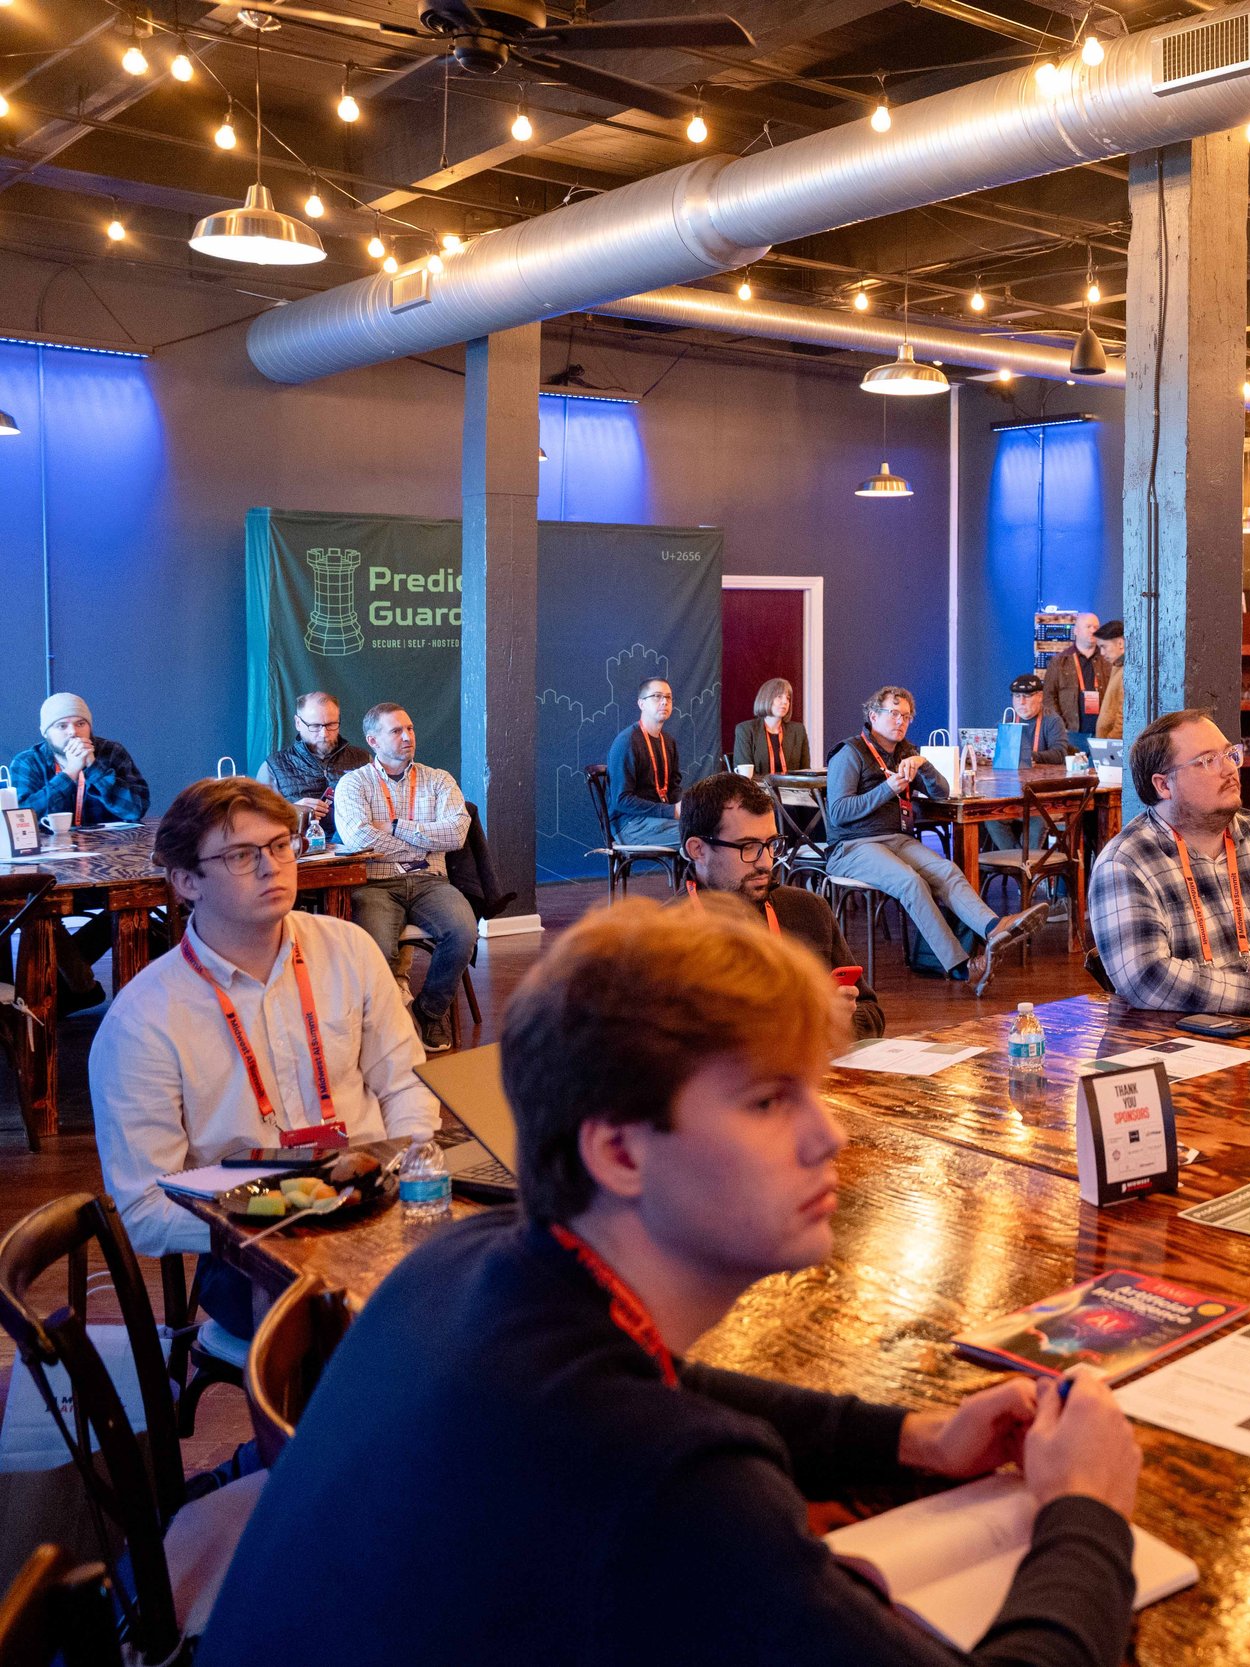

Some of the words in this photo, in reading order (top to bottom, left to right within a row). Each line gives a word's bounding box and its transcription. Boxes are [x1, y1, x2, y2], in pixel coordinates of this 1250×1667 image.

[661, 550, 701, 561] U+2656
[372, 639, 401, 648] SECURE
[1231, 873, 1240, 898] Summit
[1235, 906, 1244, 933] Midwest
[231, 1018, 249, 1056] Midwest
[307, 1012, 318, 1046] Summit
[317, 1056, 328, 1094] Midwest
[1114, 1083, 1138, 1097] THANK
[1122, 1096, 1137, 1109] YOU
[1114, 1107, 1150, 1124] SPONSORS
